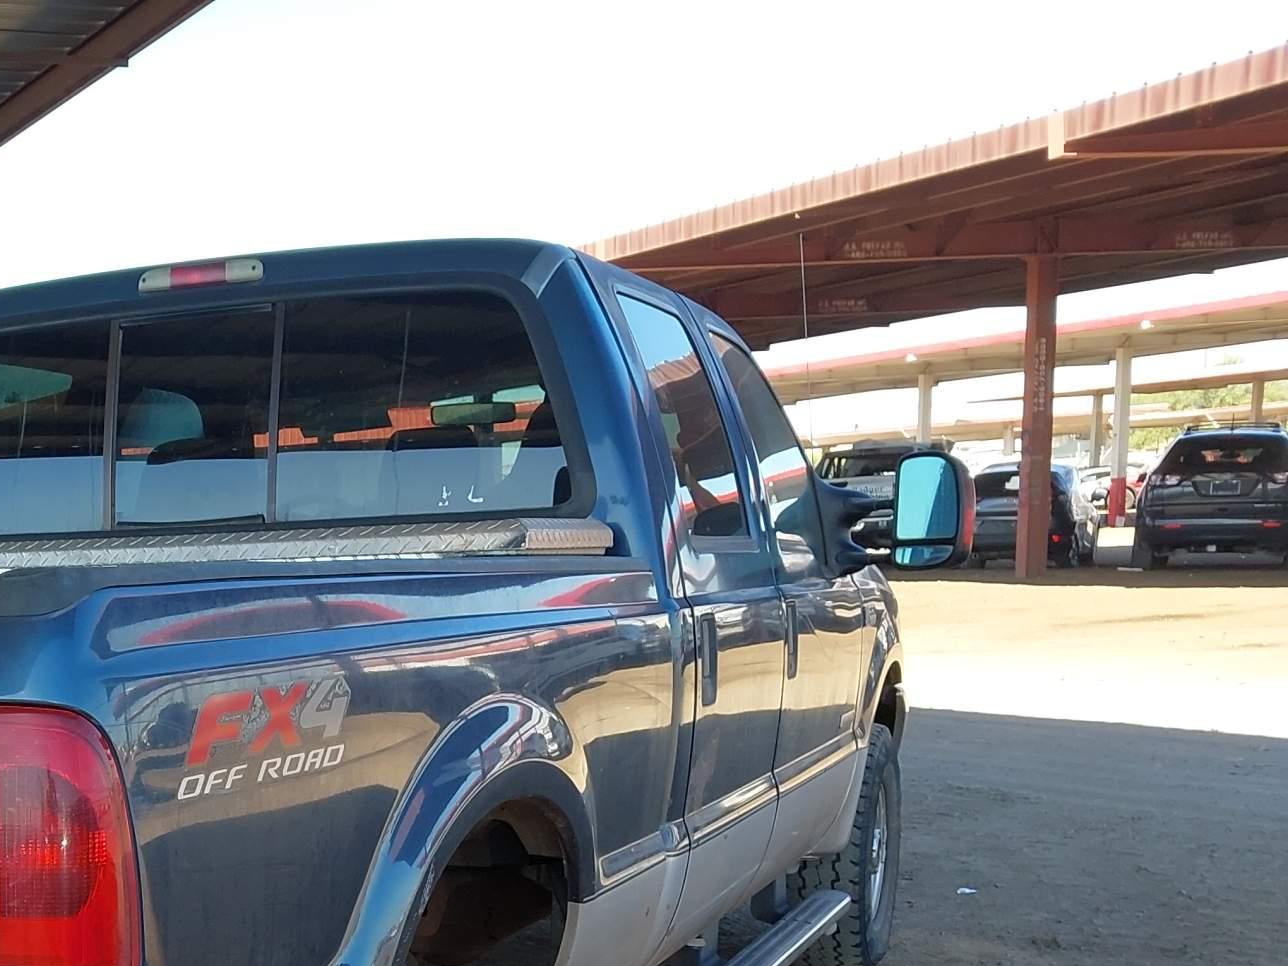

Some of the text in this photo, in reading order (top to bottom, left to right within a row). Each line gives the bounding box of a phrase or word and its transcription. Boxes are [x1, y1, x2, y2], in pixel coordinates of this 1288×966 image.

[185, 676, 351, 768] FX4
[177, 744, 345, 800] OFF ROAD
